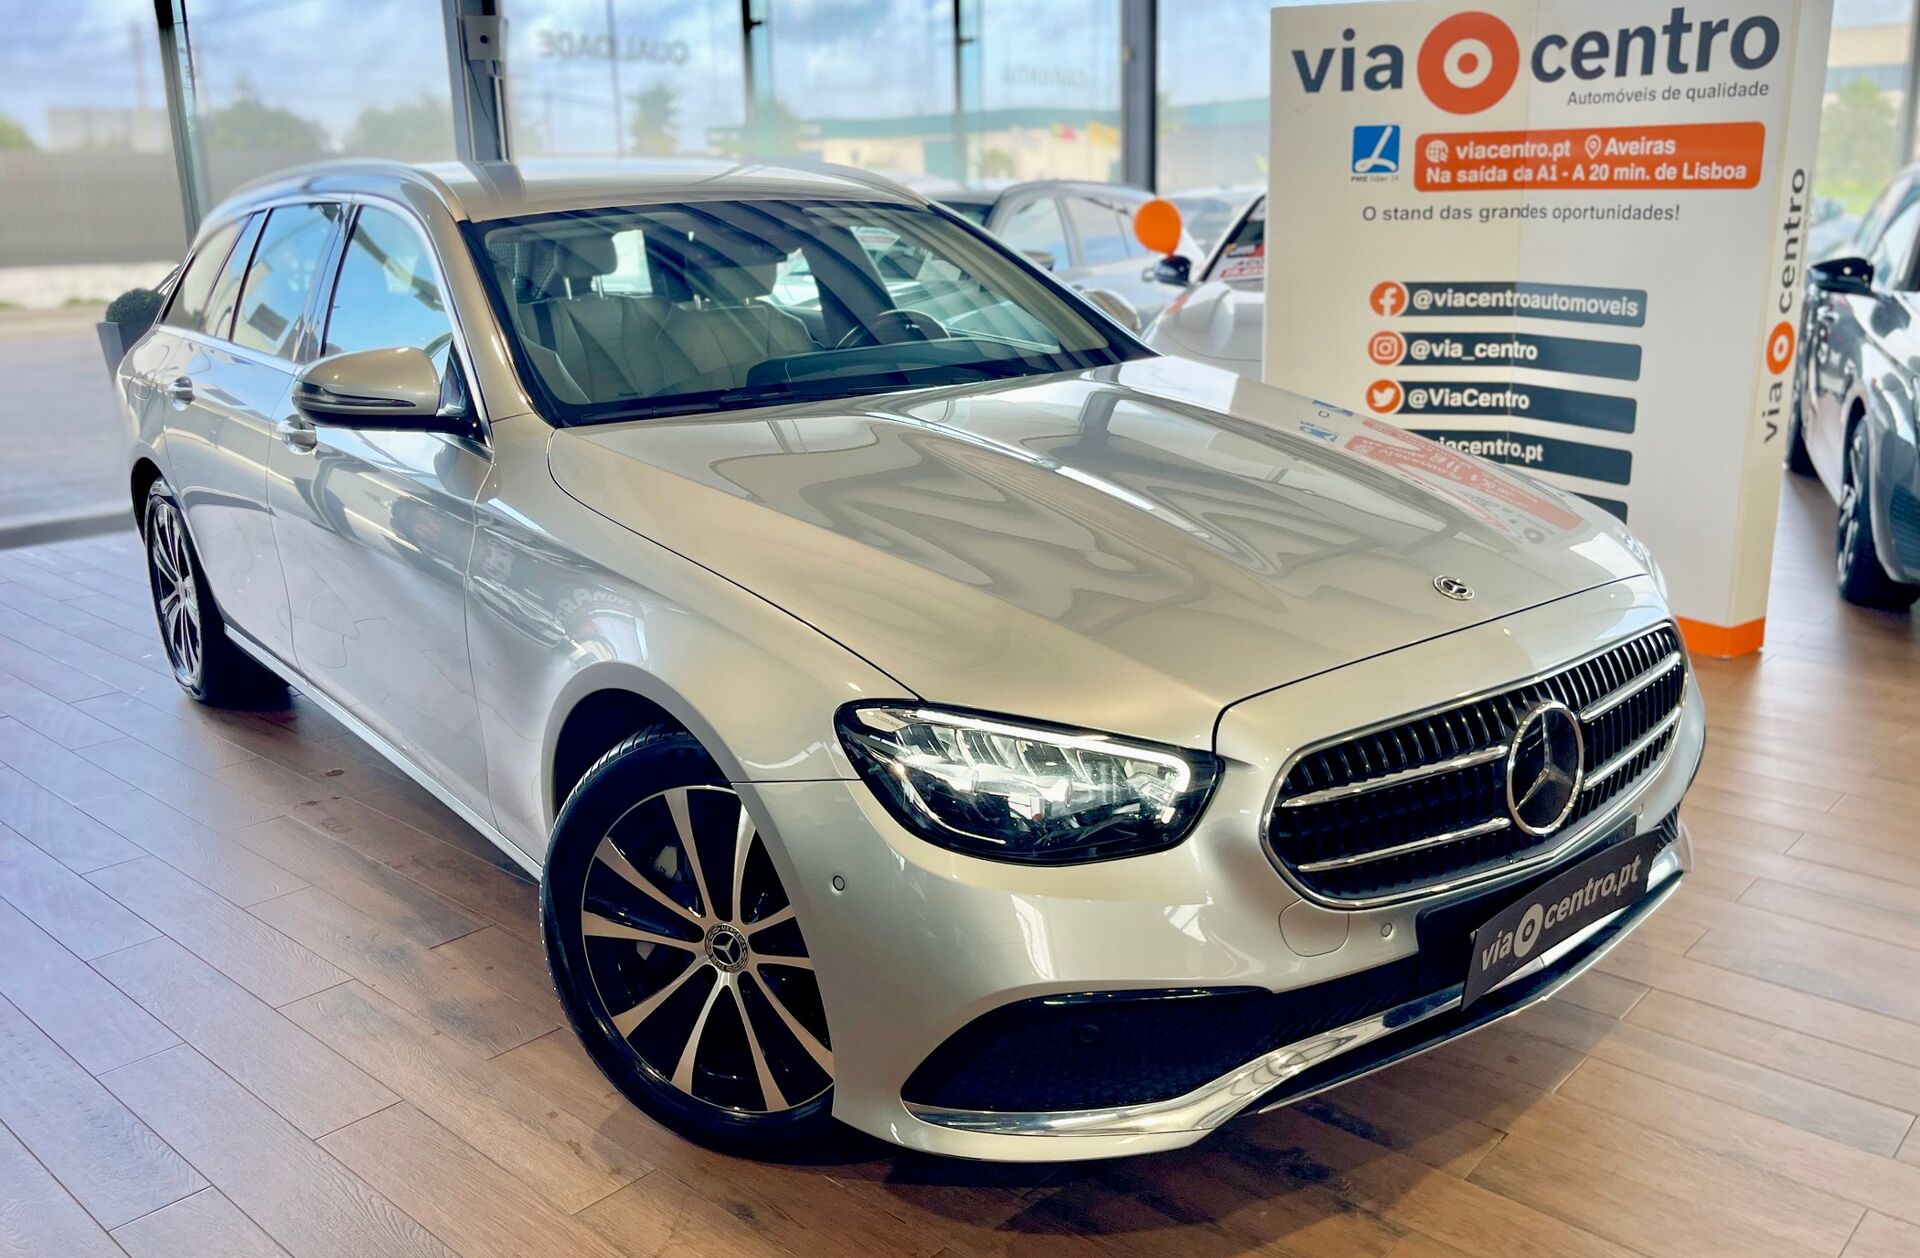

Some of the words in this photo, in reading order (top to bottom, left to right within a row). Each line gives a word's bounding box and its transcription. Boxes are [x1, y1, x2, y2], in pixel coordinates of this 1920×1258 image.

[1291, 28, 1404, 93] via
[1531, 7, 1780, 83] centro
[1567, 88, 1656, 106] Automóveis
[1661, 86, 1681, 101] de
[1686, 81, 1769, 103] qualidade
[1456, 140, 1571, 161] viacentro.pt
[1604, 136, 1676, 156] Aveiras
[1426, 167, 1451, 183] Na
[1456, 165, 1508, 183] saída
[1513, 165, 1533, 181] da
[1536, 164, 1557, 181] A1
[1572, 164, 1585, 181] A
[1589, 164, 1609, 181] 20
[1613, 163, 1650, 181] min.
[1654, 162, 1677, 180] de
[1682, 162, 1746, 180] Lisboa
[1362, 206, 1377, 221] O
[1382, 205, 1434, 221] stand
[1440, 205, 1472, 220] das
[1479, 204, 1547, 223] grandes
[1552, 204, 1680, 222] oportunidades!
[1413, 289, 1638, 317] @viacentroautomoveis
[1762, 381, 1783, 444] via
[1779, 168, 1806, 315] centro
[1410, 339, 1538, 360] @via_centro
[1408, 388, 1530, 410] @ViaCentro
[1481, 929, 1513, 972] via
[1544, 854, 1642, 930] centro.pt
